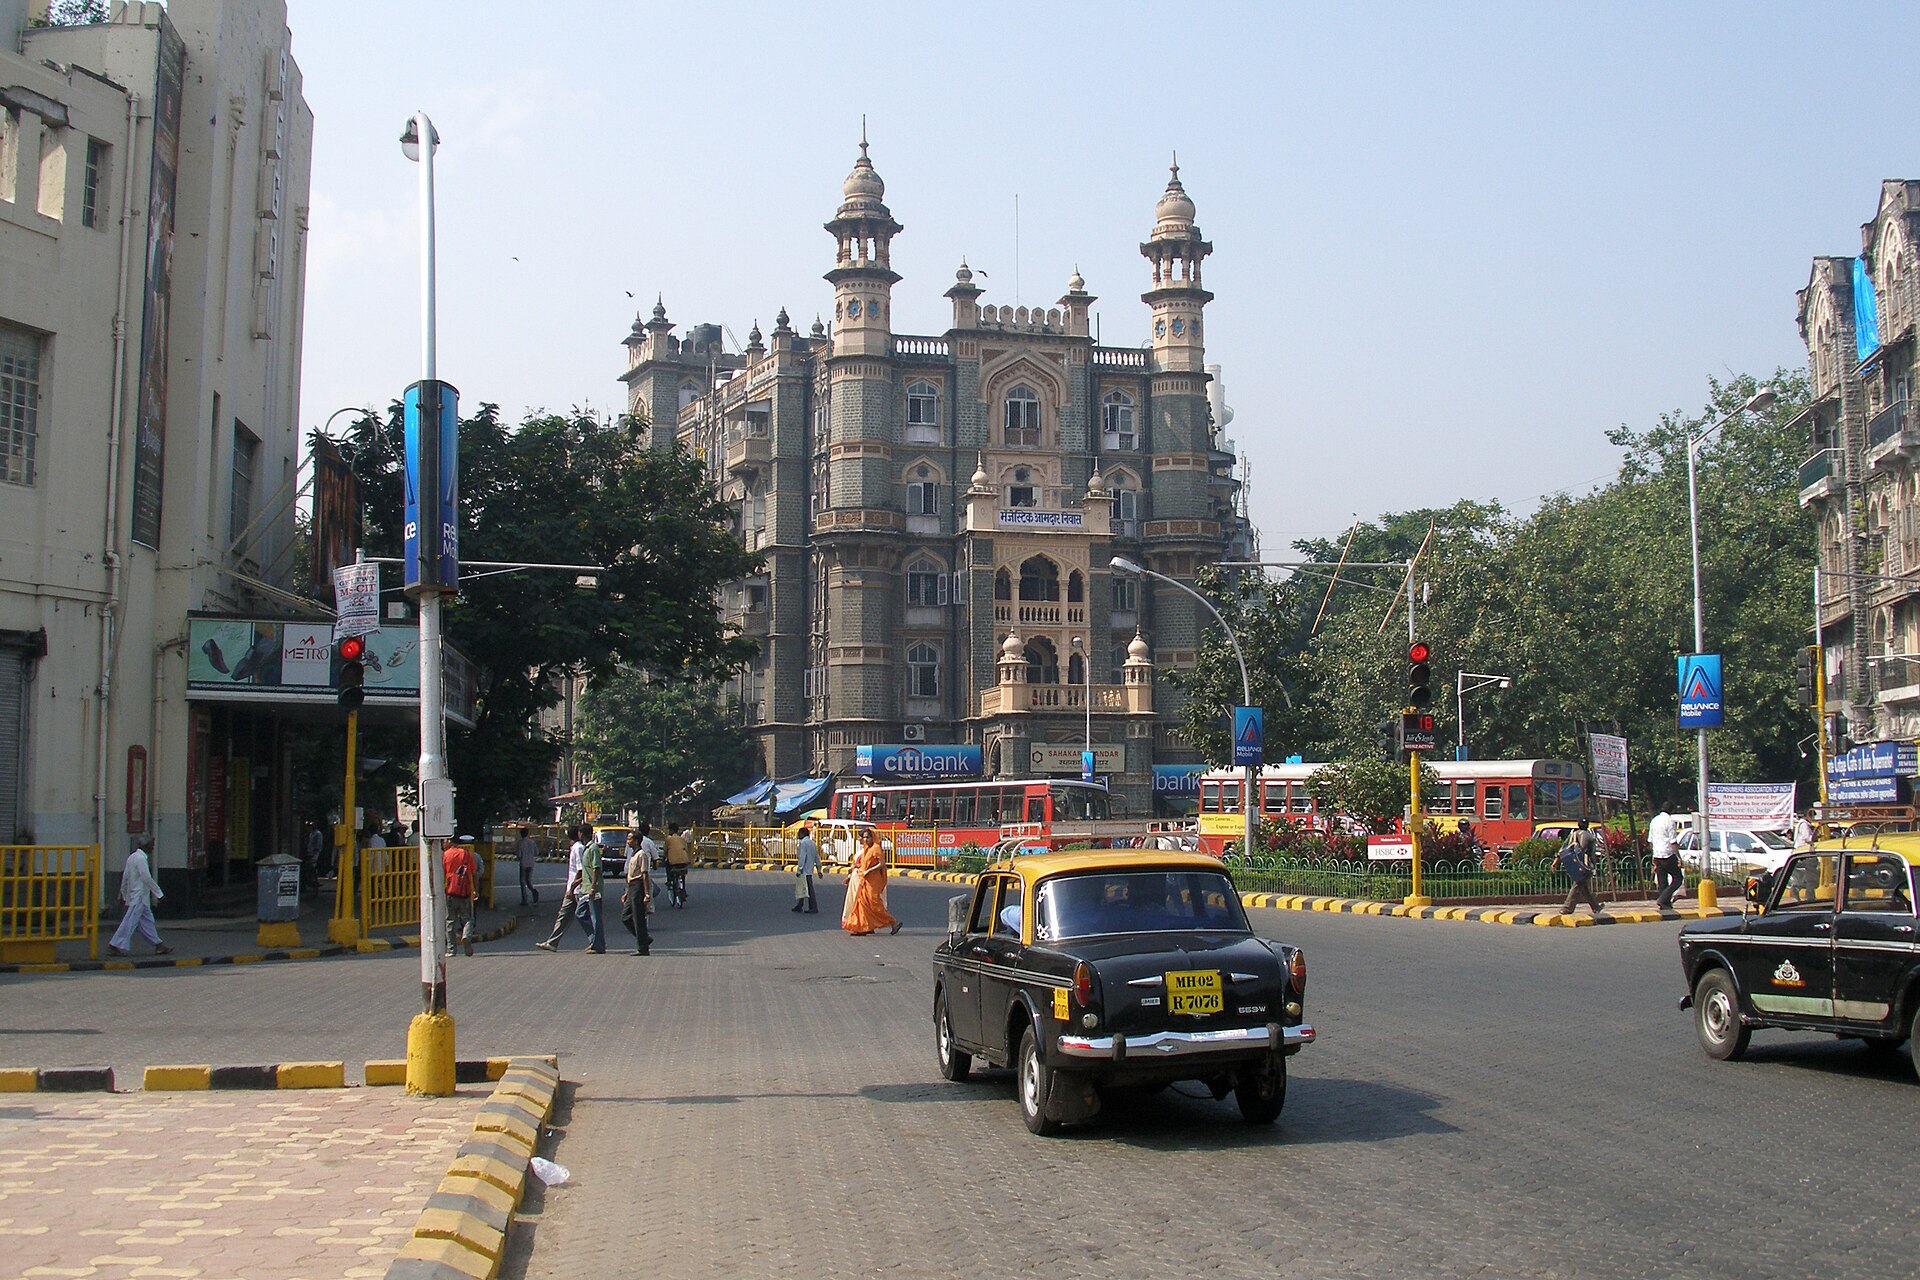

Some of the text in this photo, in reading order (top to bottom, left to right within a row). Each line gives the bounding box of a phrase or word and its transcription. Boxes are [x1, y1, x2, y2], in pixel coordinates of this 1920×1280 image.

[284, 648, 330, 660] METRO
[1419, 716, 1433, 730] 18
[884, 751, 969, 772] citibank
[1375, 848, 1395, 856] HSBC
